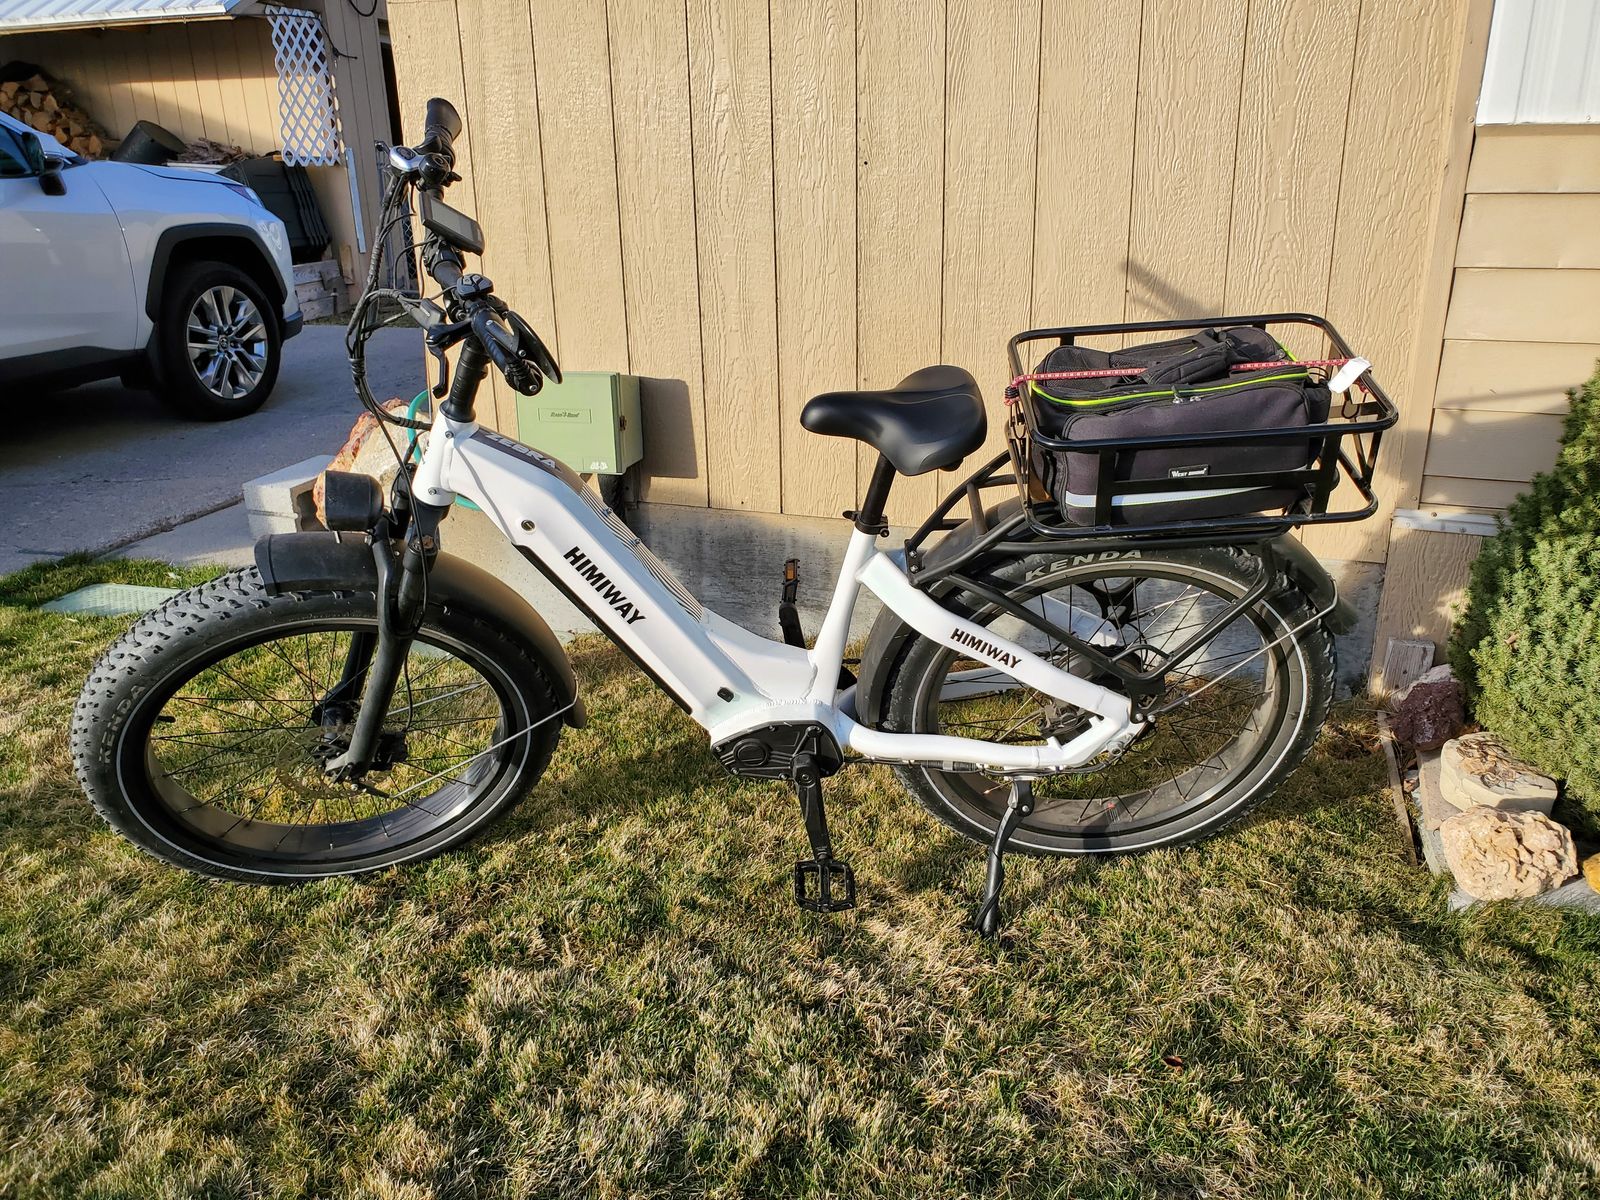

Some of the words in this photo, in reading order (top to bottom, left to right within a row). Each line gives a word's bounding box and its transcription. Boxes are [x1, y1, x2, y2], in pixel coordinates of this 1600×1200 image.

[485, 432, 557, 469] ZEBRA
[563, 546, 646, 625] HIMIWAY
[1025, 549, 1142, 582] KENDA
[950, 627, 1022, 669] HIMIWAY
[98, 685, 147, 764] KENDA
